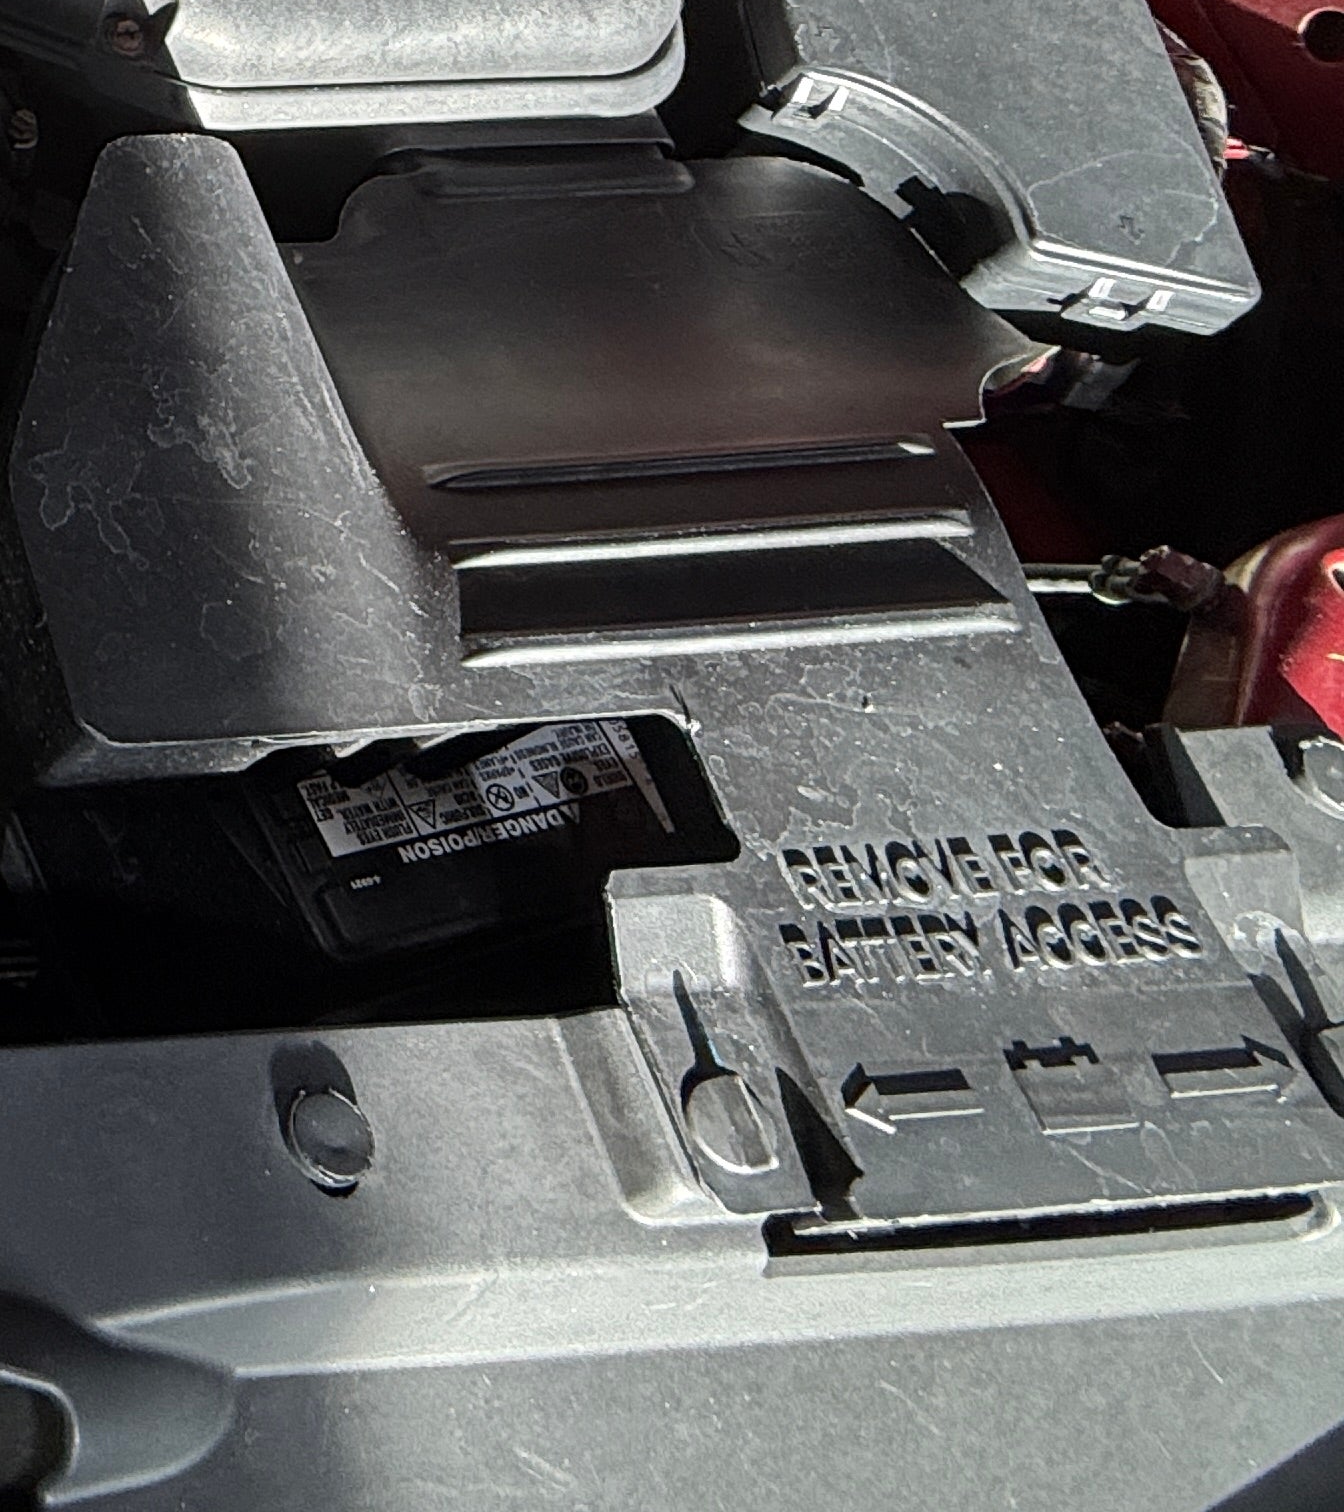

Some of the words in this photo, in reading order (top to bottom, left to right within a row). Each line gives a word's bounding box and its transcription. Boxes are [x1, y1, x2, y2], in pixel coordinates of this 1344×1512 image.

[397, 809, 565, 864] DANGER/POISON
[781, 835, 998, 909] REMOVE
[987, 827, 1115, 895] FOR
[779, 910, 994, 987] BATTERY
[998, 894, 1203, 971] ACCESS
